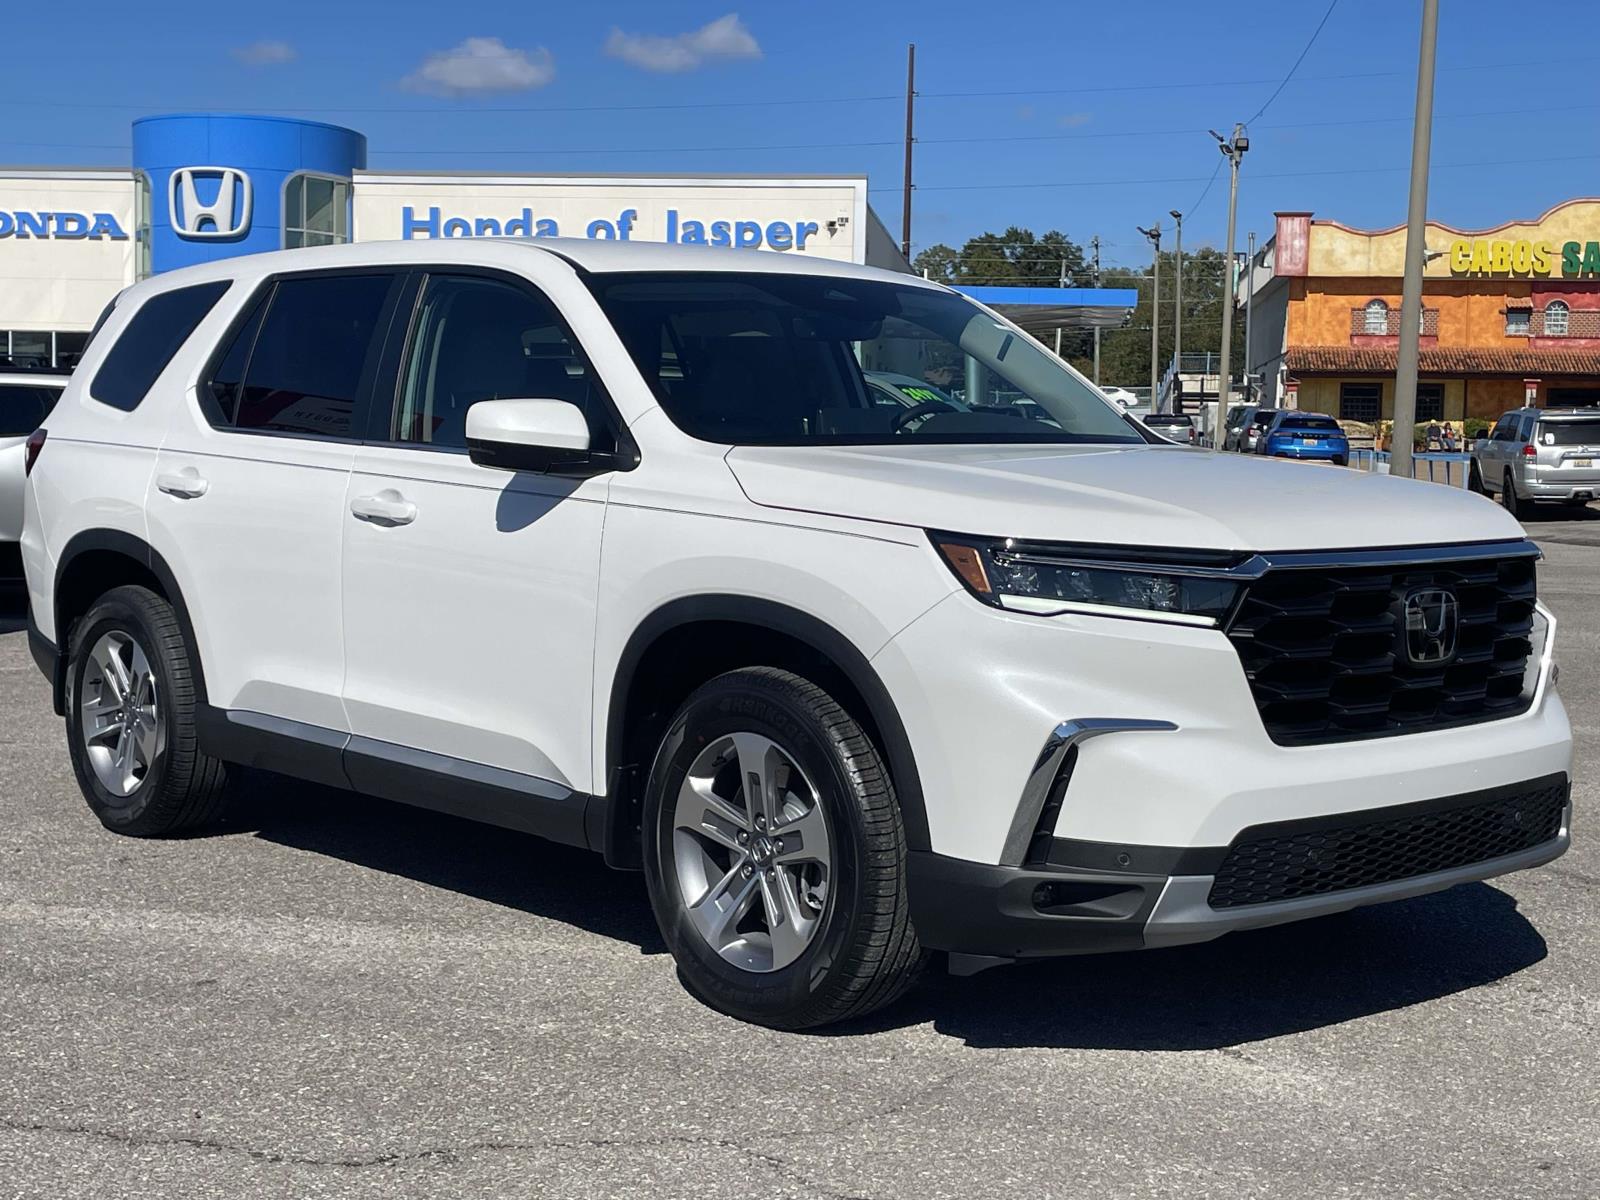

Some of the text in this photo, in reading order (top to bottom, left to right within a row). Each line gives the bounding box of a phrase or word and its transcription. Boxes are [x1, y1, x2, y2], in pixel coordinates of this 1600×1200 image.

[402, 206, 819, 251] Honda of Jasper
[1450, 239, 1554, 273] CABOS
